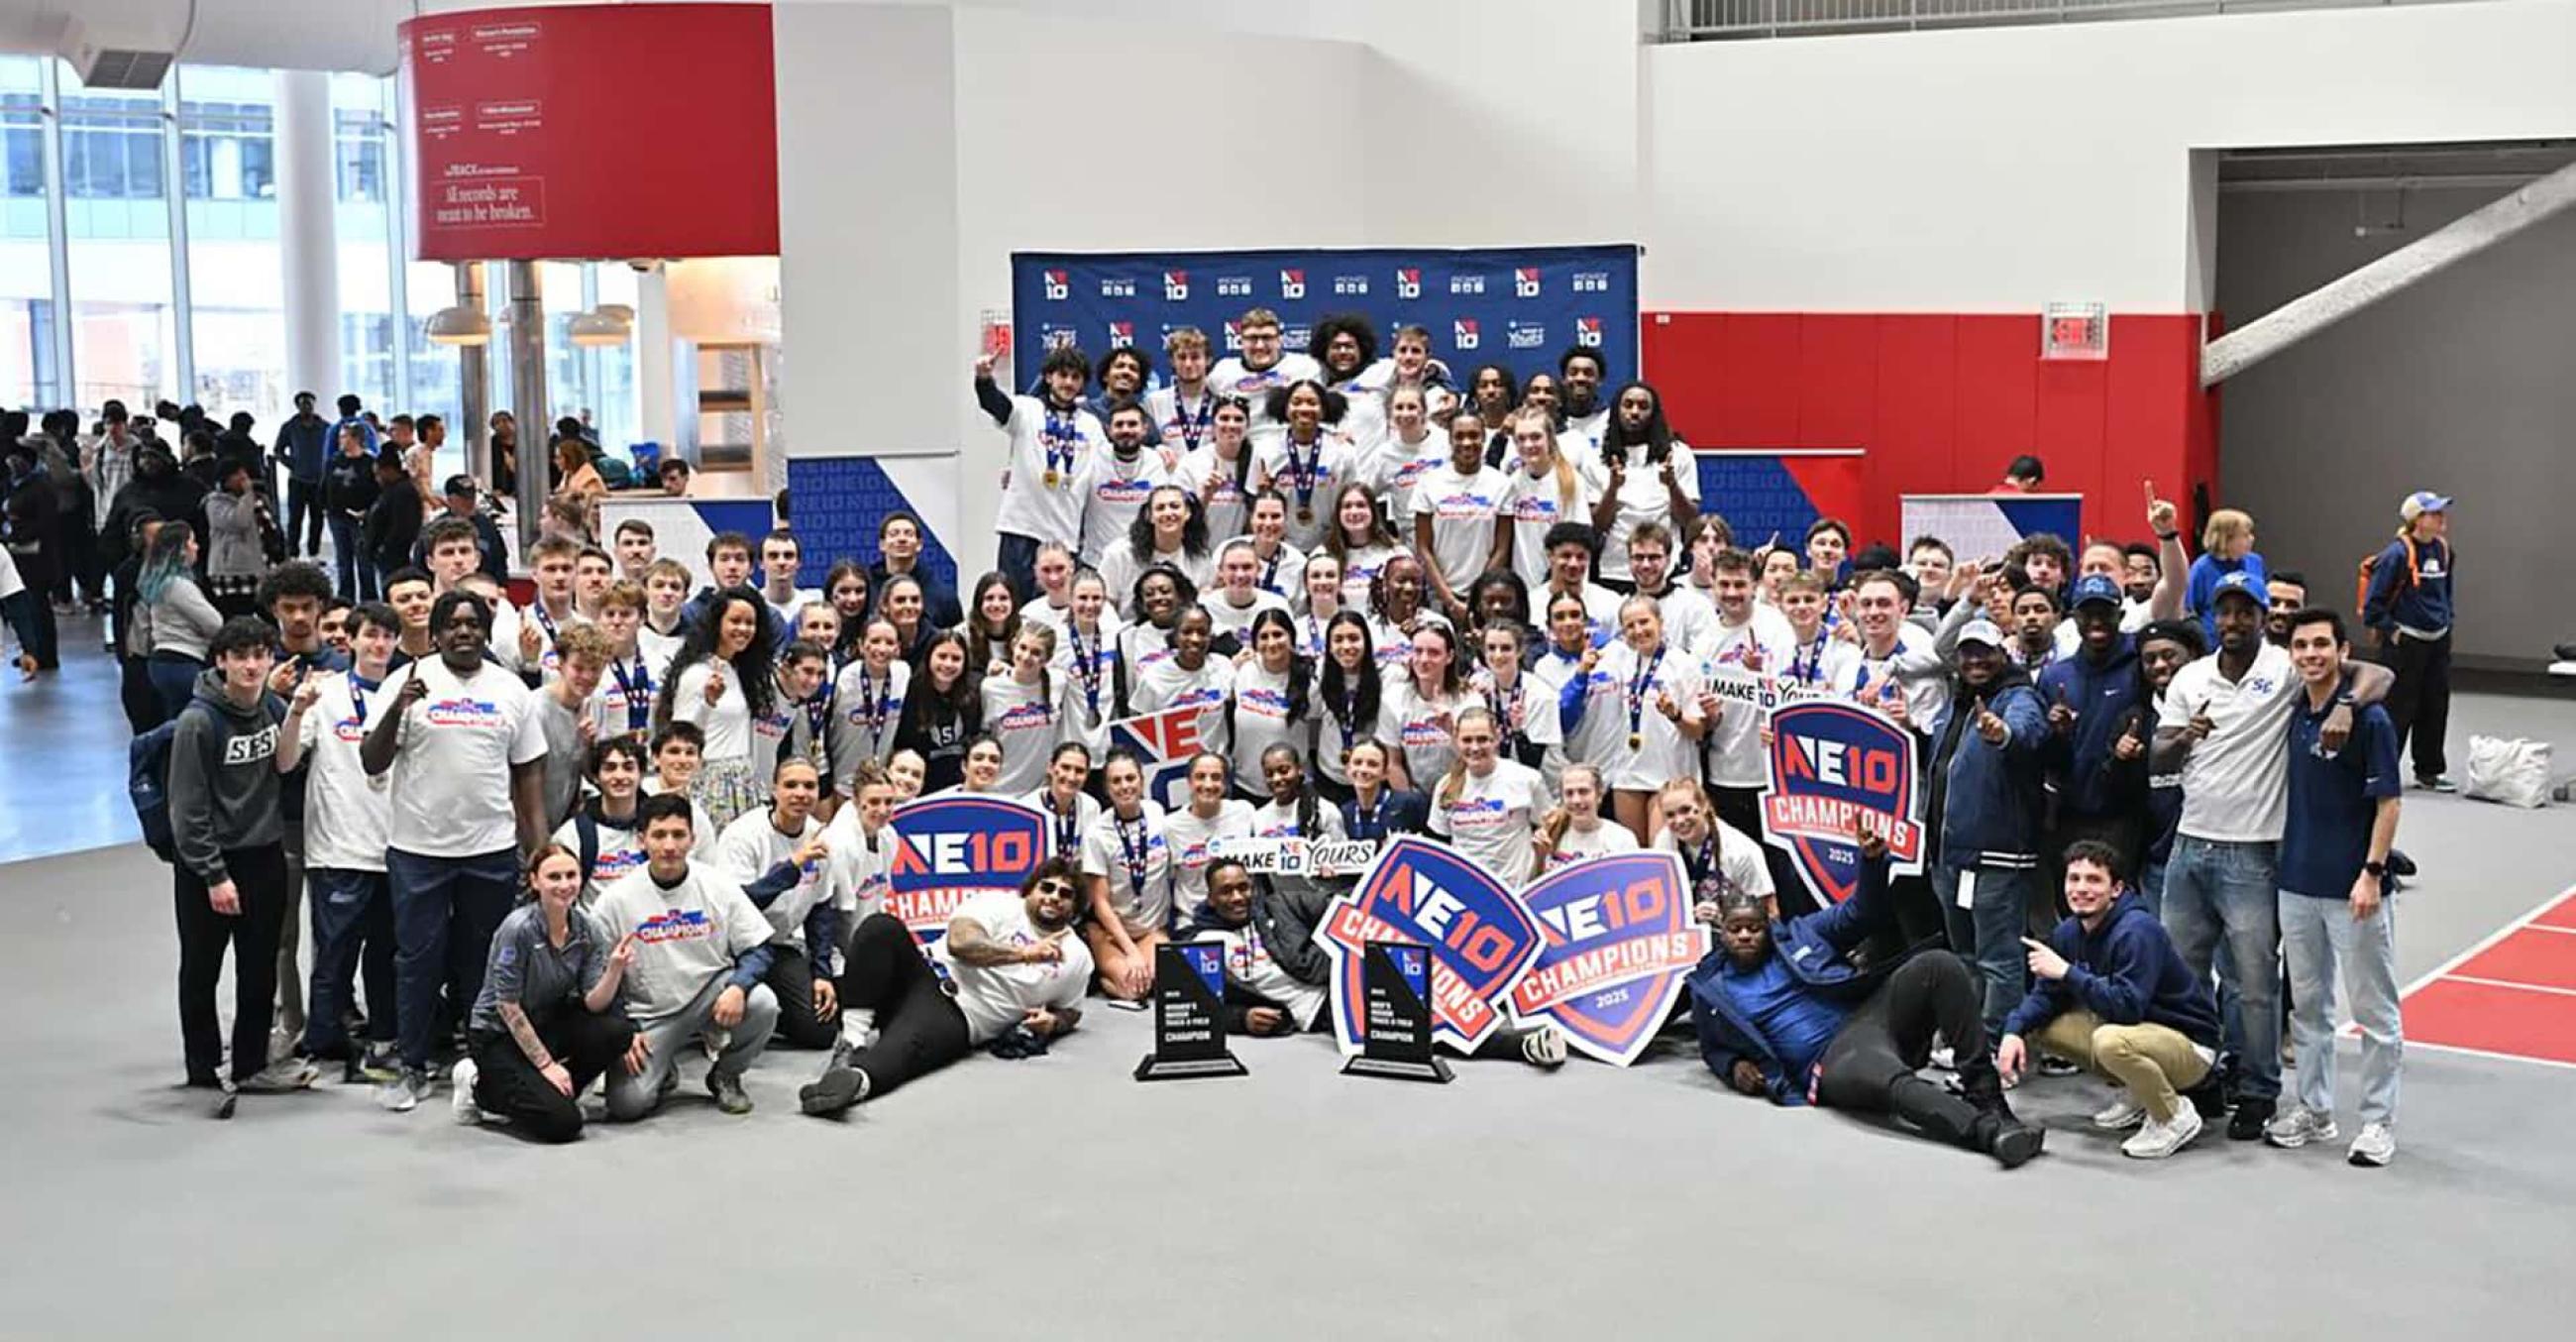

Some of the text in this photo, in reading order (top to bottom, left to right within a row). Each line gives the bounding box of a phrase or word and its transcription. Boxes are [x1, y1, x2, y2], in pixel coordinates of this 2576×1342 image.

[498, 188, 518, 201] are
[475, 202, 488, 221] be
[489, 201, 535, 221] broken.
[1046, 284, 1068, 299] 10
[1165, 285, 1188, 299] 10
[1283, 283, 1305, 298] 10
[1399, 283, 1421, 297] 10
[1516, 282, 1540, 297] 10
[1455, 333, 1479, 349] 10
[1578, 332, 1602, 347] 10
[1712, 679, 1755, 701] MAKE
[1760, 692, 1776, 708] 10
[1784, 732, 1896, 793] NE10
[1775, 796, 1907, 847] CHAMPONS
[893, 832, 1030, 874] NE10
[1279, 855, 1301, 870] 10
[1305, 840, 1371, 873] YOURS
[1381, 862, 1516, 972] NE10
[1522, 932, 1689, 1002] CHAMPIONS
[1595, 988, 1630, 1009] 2025
